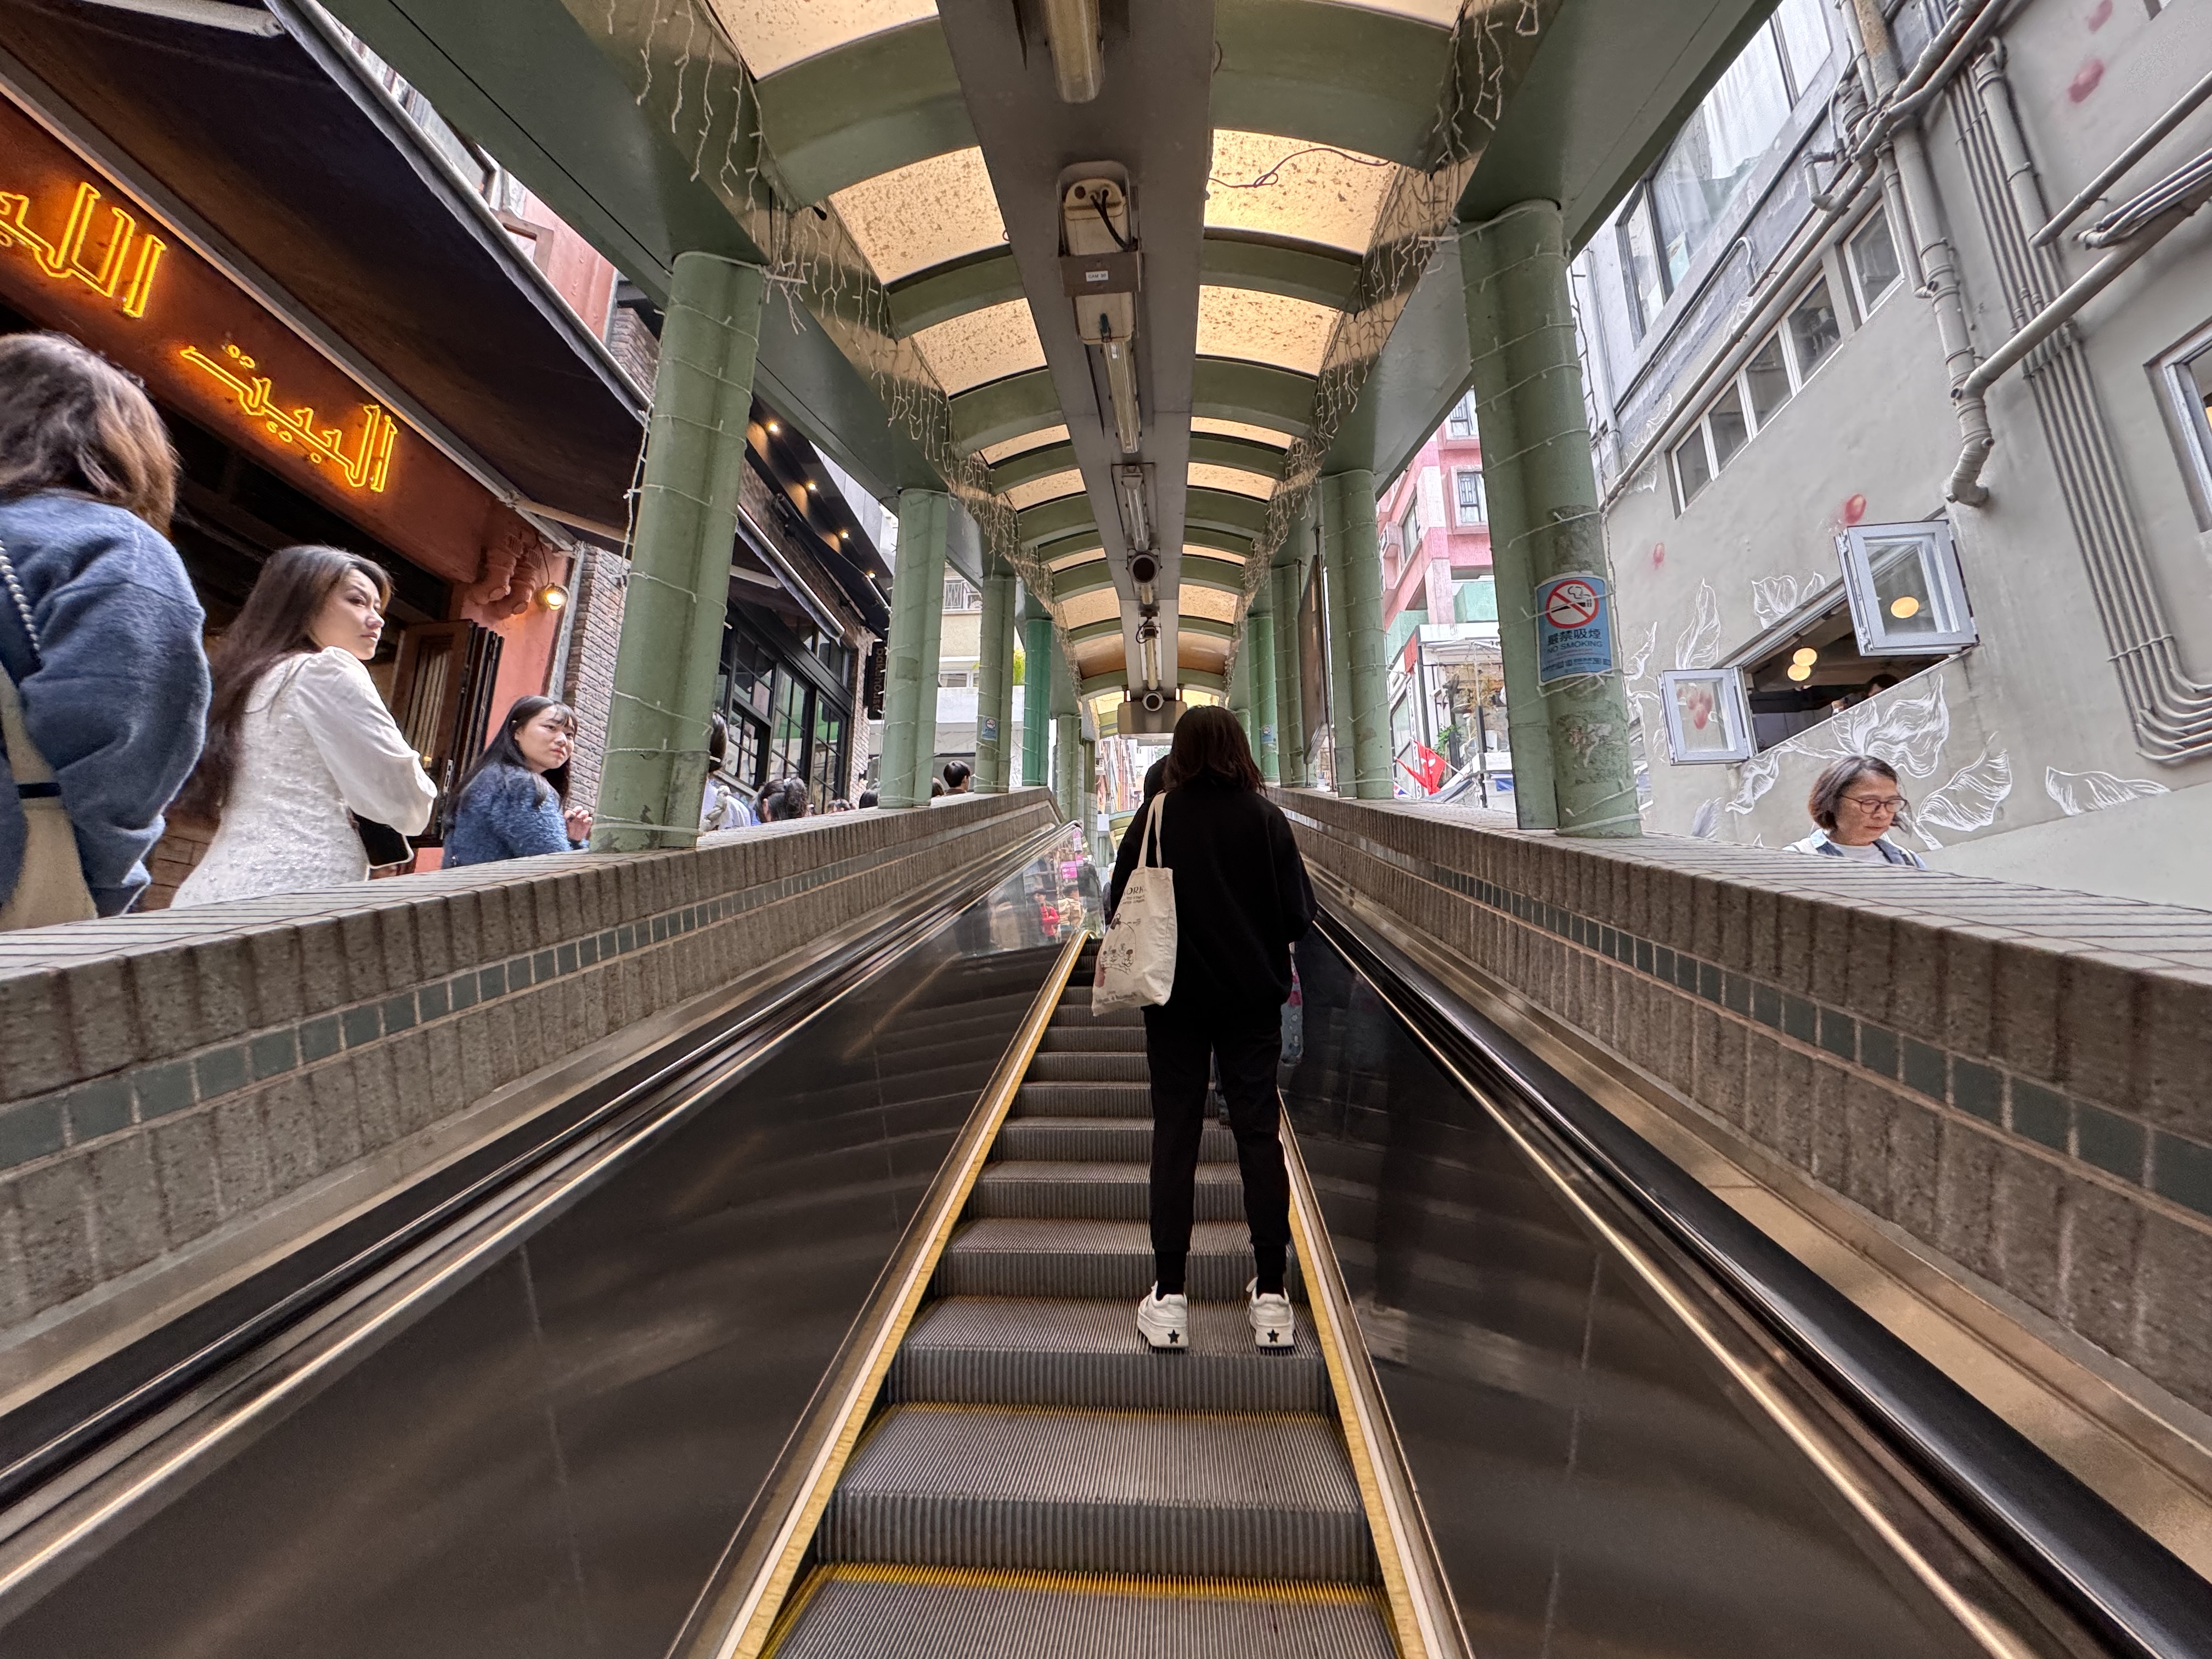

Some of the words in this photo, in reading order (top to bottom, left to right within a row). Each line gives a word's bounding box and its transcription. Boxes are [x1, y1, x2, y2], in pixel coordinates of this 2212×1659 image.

[1548, 628, 1601, 646] 嚴禁吸煙
[1560, 640, 1603, 650] SMOKING
[873, 647, 885, 712] bakehouse
[1124, 885, 1144, 896] ORK
